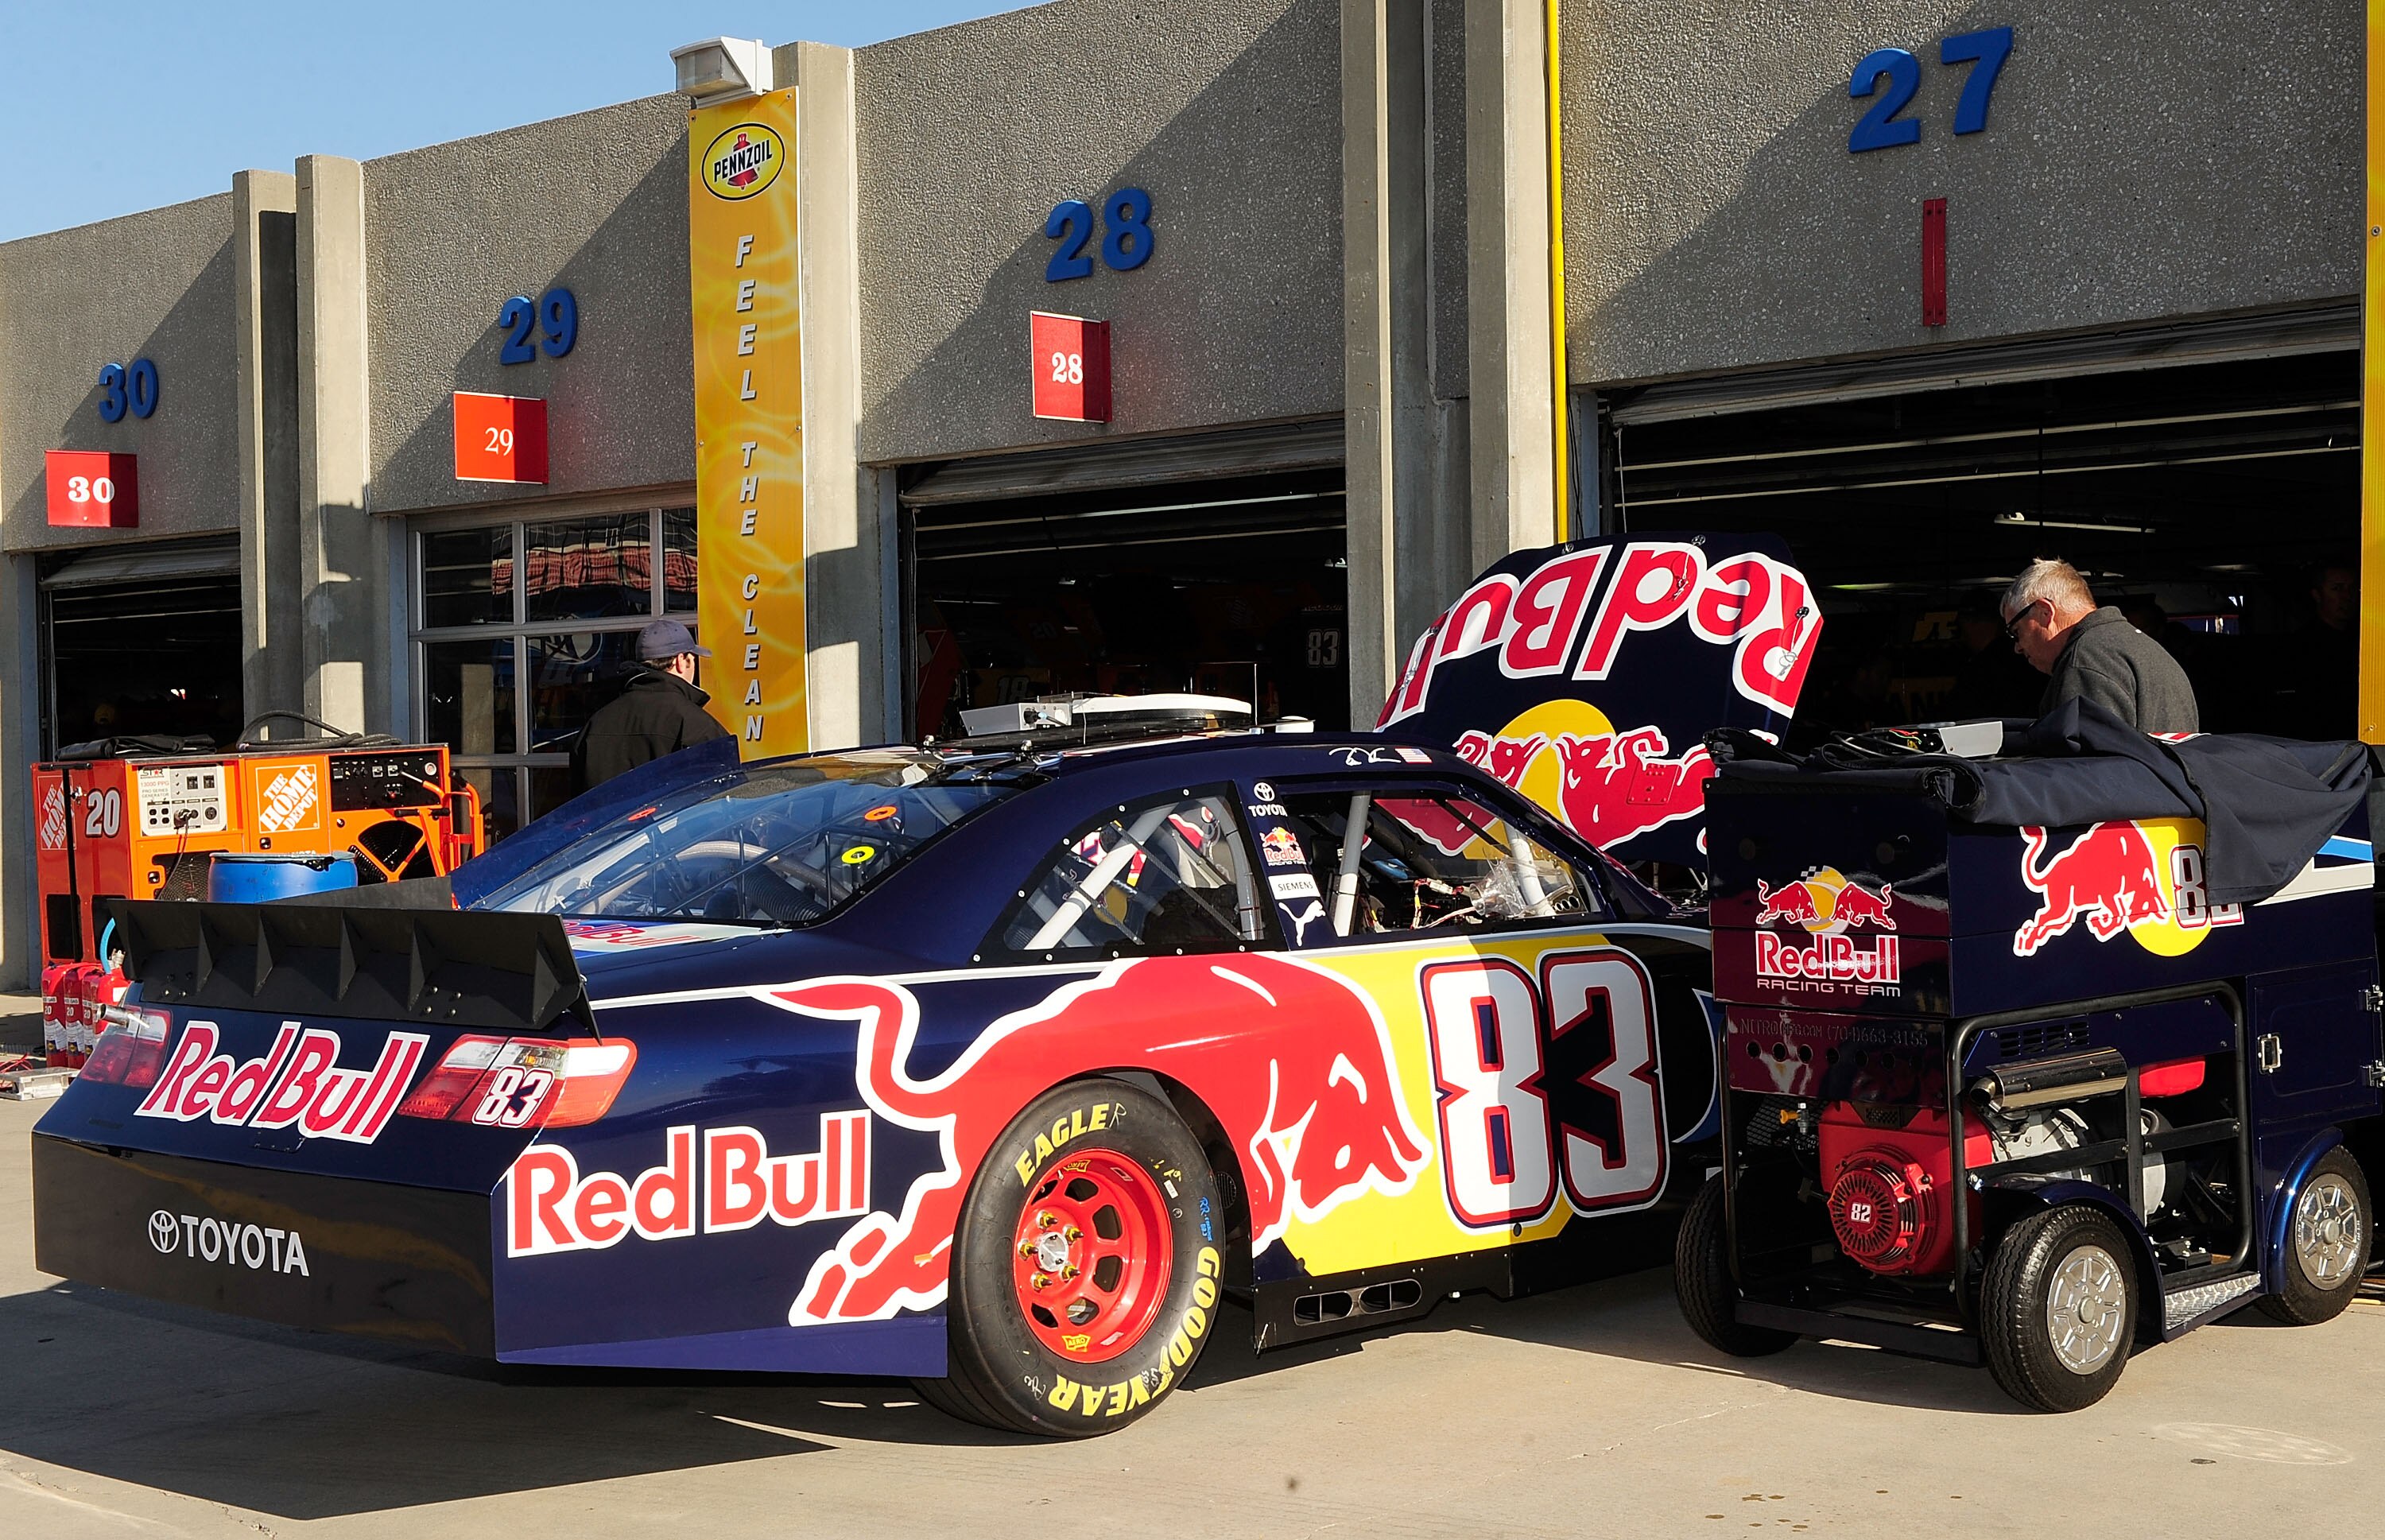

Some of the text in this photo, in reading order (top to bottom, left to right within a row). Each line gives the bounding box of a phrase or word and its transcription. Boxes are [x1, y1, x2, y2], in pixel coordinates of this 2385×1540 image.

[1848, 26, 2014, 153] 27
[712, 138, 774, 184] PENNZOIL
[1045, 188, 1154, 282] 28
[499, 287, 579, 366] 29
[98, 358, 159, 424] 30
[1051, 351, 1084, 386] 28
[483, 427, 514, 456] 29
[67, 475, 115, 504] 30
[735, 235, 763, 740] FEEL THE CLEAN
[1305, 627, 1341, 669] 83
[1572, 541, 1824, 720] Red
[43, 784, 56, 813] THE
[259, 764, 316, 833] HOME
[263, 773, 289, 799] THE
[282, 788, 316, 831] DEPOT
[1247, 804, 1288, 817] TOYOTA
[41, 780, 70, 849] HOM
[85, 786, 122, 838] 20
[1262, 848, 1287, 863] Red
[1278, 881, 1313, 891] SIEMENS
[2170, 843, 2245, 930] 8
[1755, 930, 1900, 983] Red Bull
[45, 1006, 52, 1015] 20
[66, 1007, 75, 1016] 20
[1757, 978, 1901, 997] RACING TEAM
[83, 1010, 91, 1019] 20
[134, 1021, 431, 1145] Red Bull
[472, 1065, 556, 1129] 83
[1415, 944, 1670, 1234] 83
[1014, 1104, 1111, 1187] EAGLE
[507, 1108, 872, 1259] Red Bull
[1850, 1203, 1872, 1224] 82
[180, 1214, 311, 1278] TOYOTA
[1068, 1336, 1087, 1348] AERO
